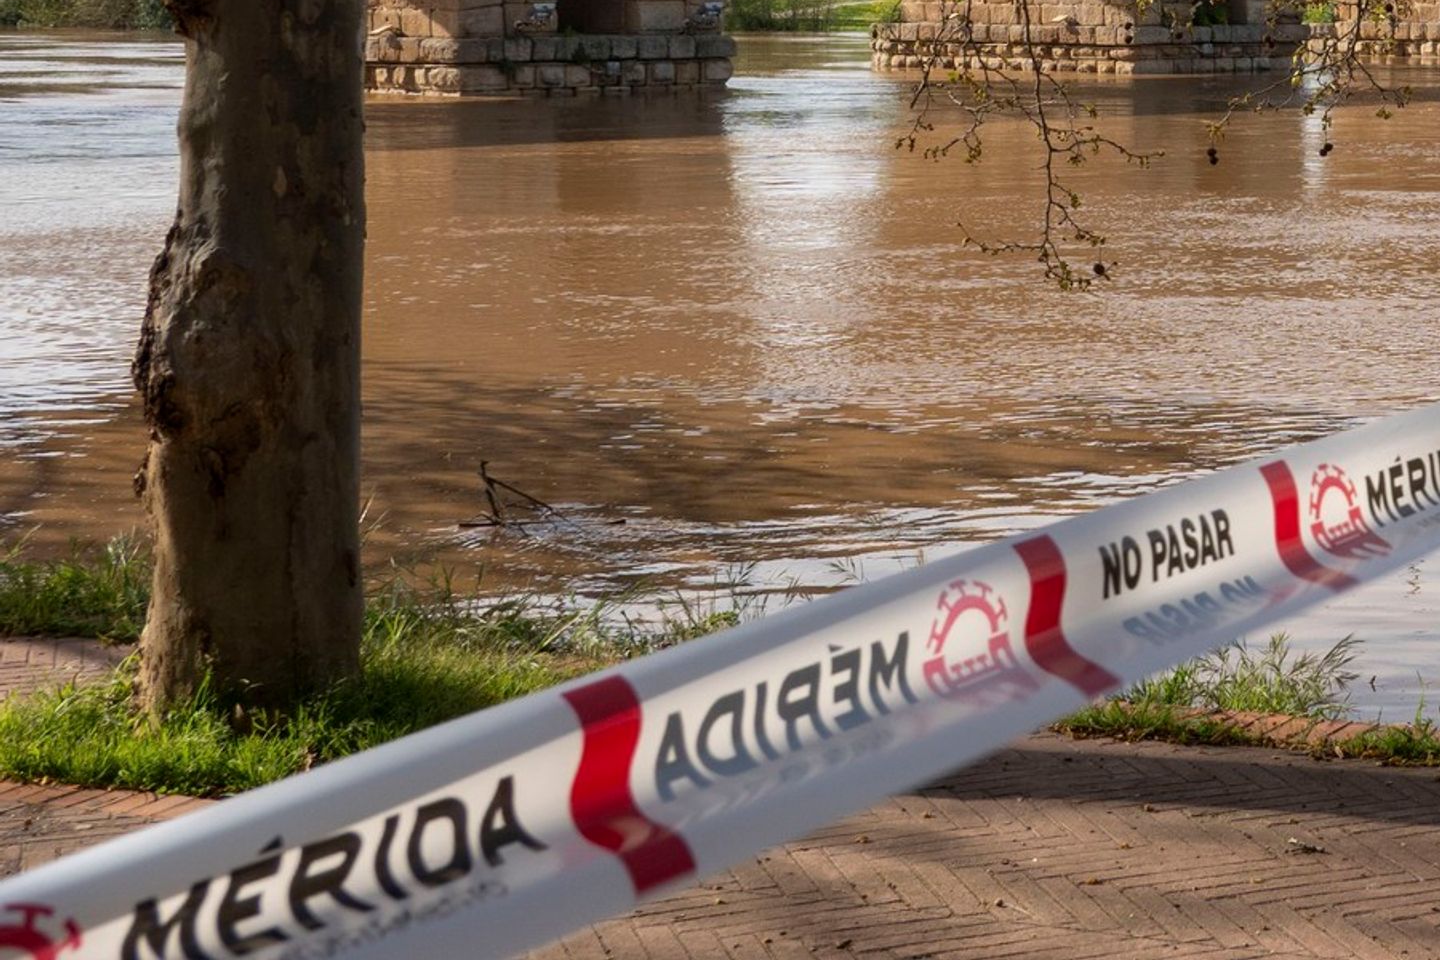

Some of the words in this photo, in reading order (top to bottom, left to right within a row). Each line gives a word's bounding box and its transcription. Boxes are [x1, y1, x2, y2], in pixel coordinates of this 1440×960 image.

[1098, 535, 1141, 599] NO
[1147, 509, 1234, 582] PASAR
[121, 775, 547, 960] MÉRIDA
